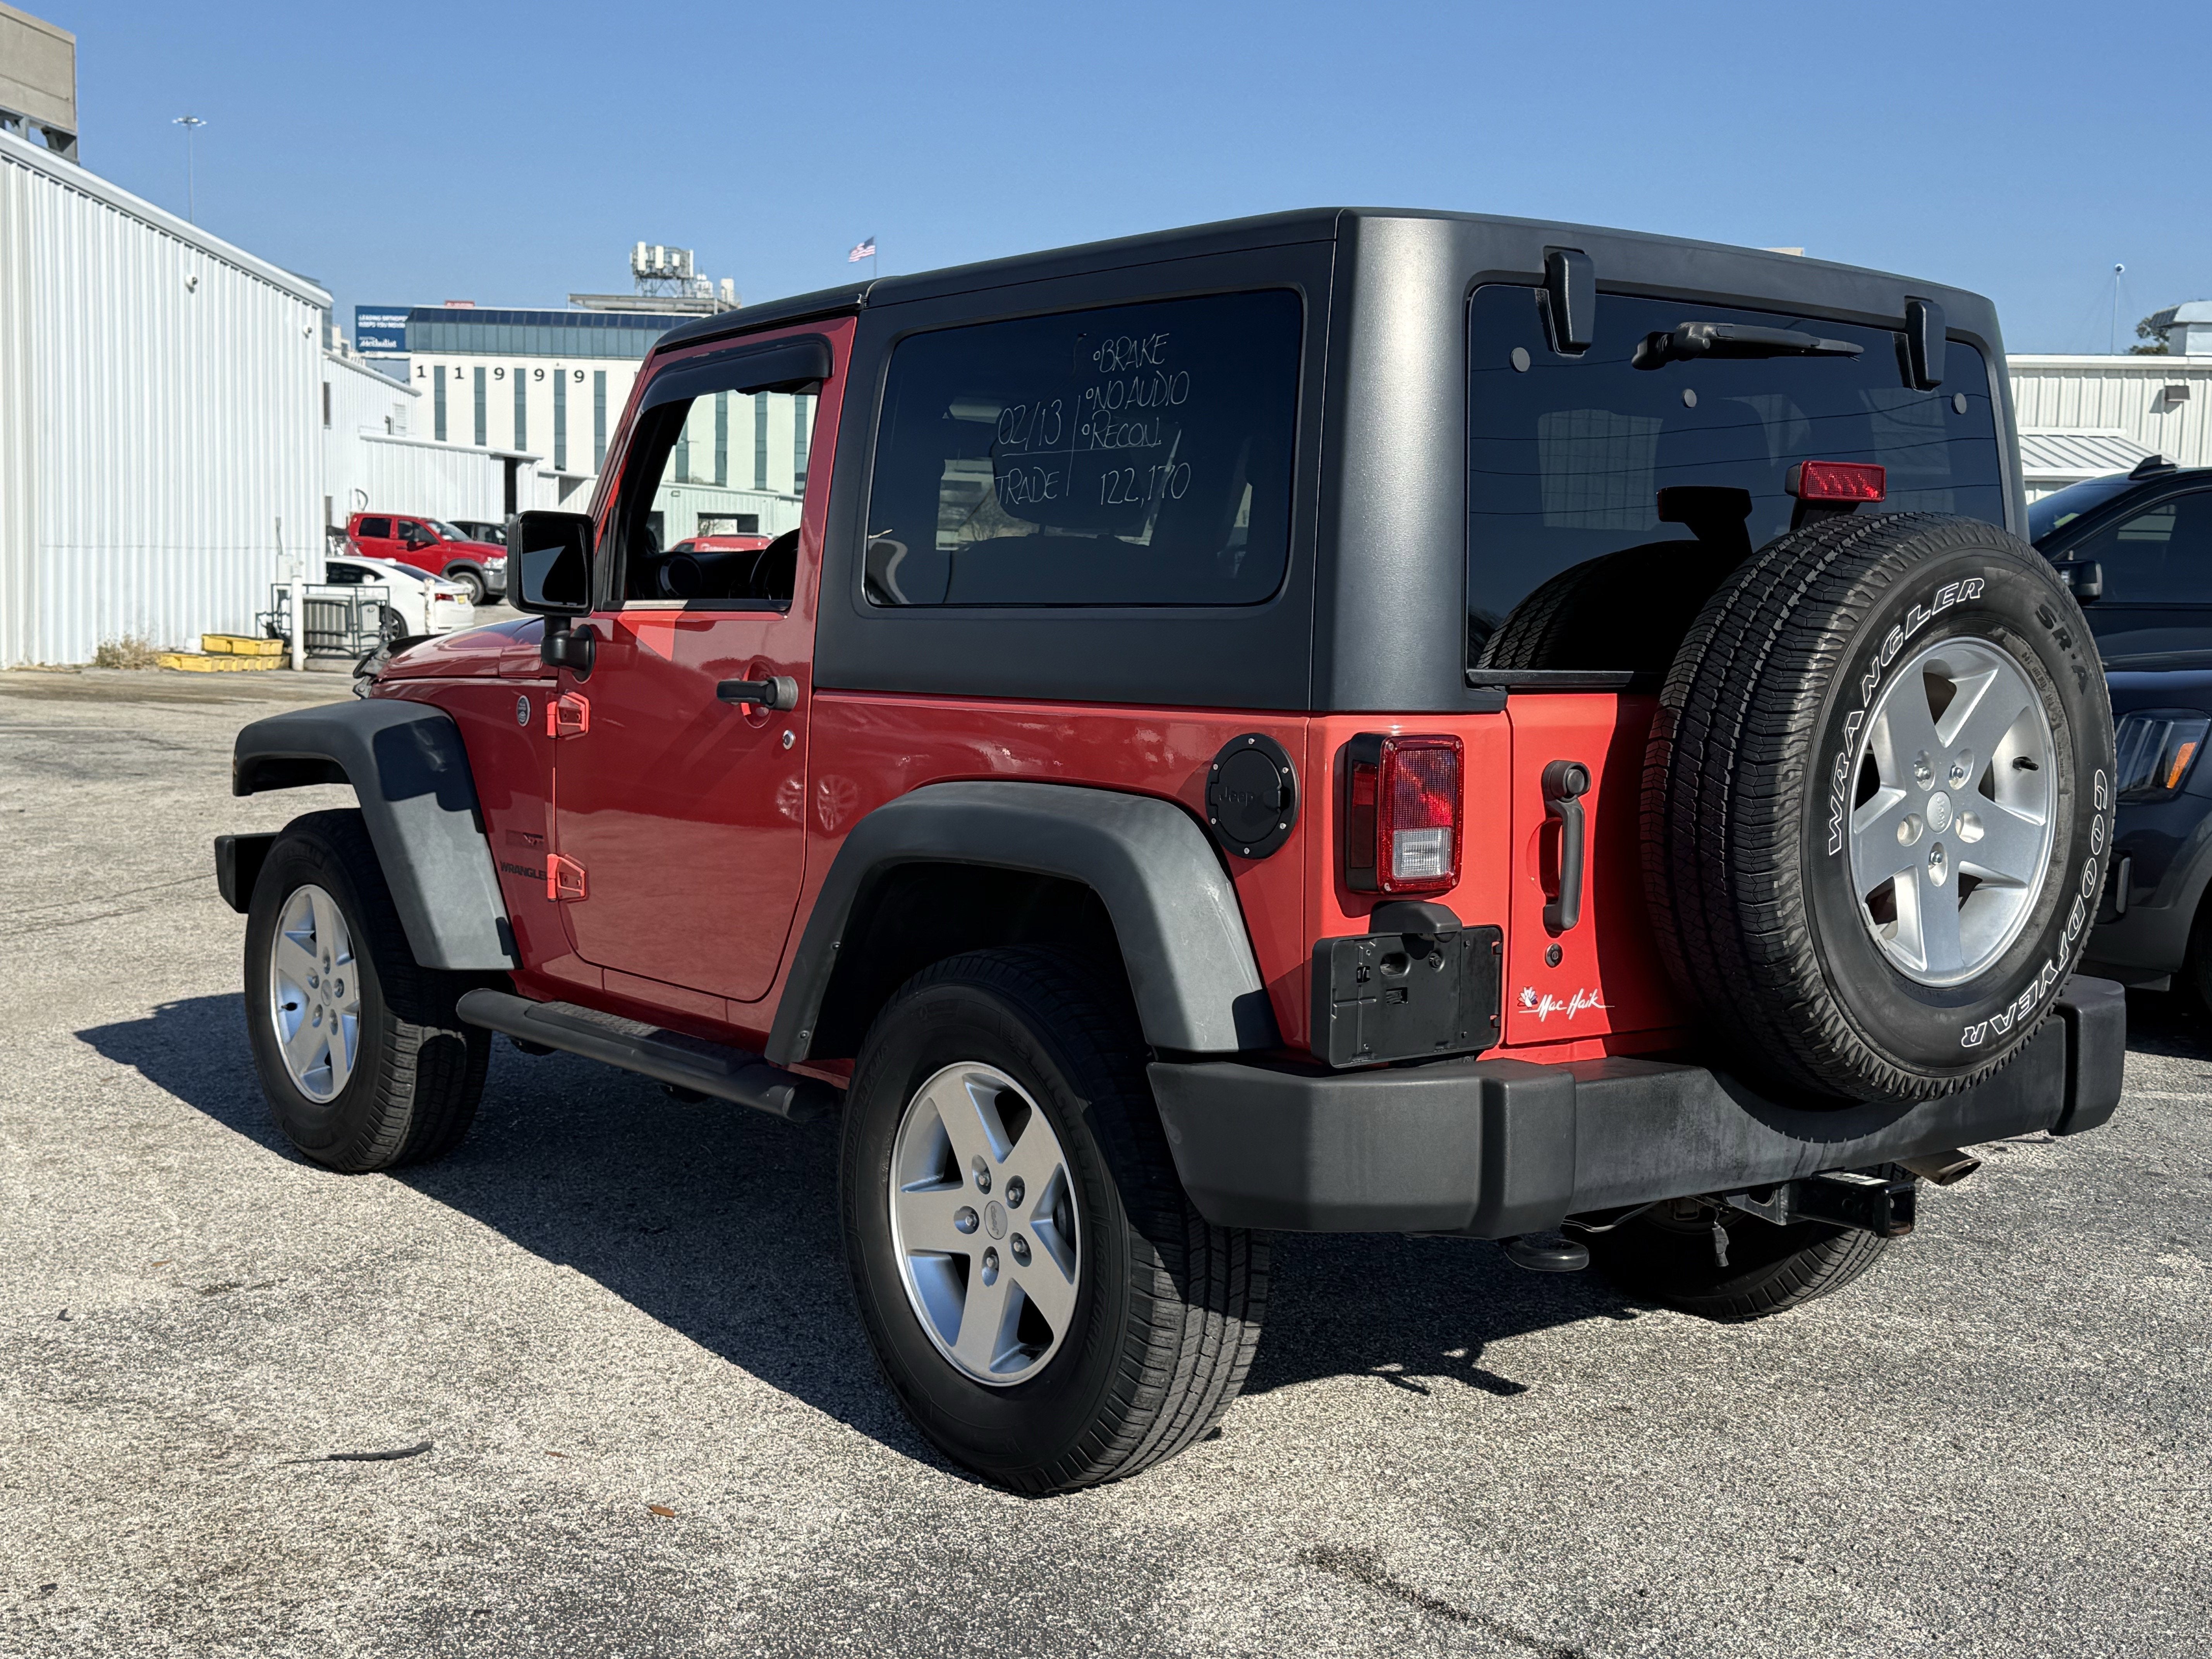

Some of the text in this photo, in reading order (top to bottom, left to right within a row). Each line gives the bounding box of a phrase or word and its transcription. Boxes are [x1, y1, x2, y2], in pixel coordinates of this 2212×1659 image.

[1099, 333, 1169, 373] BRAKE
[1092, 371, 1189, 410] NO AUDIO
[998, 399, 1062, 450] 02/13
[995, 467, 1060, 504] TRADE
[1101, 462, 1190, 508] 122,170
[1829, 577, 1985, 856] WRANGLER
[500, 860, 547, 881] WRANGLE
[1961, 769, 2108, 1048] GOODYEAR
[1519, 988, 1615, 1022] Mac Haik
